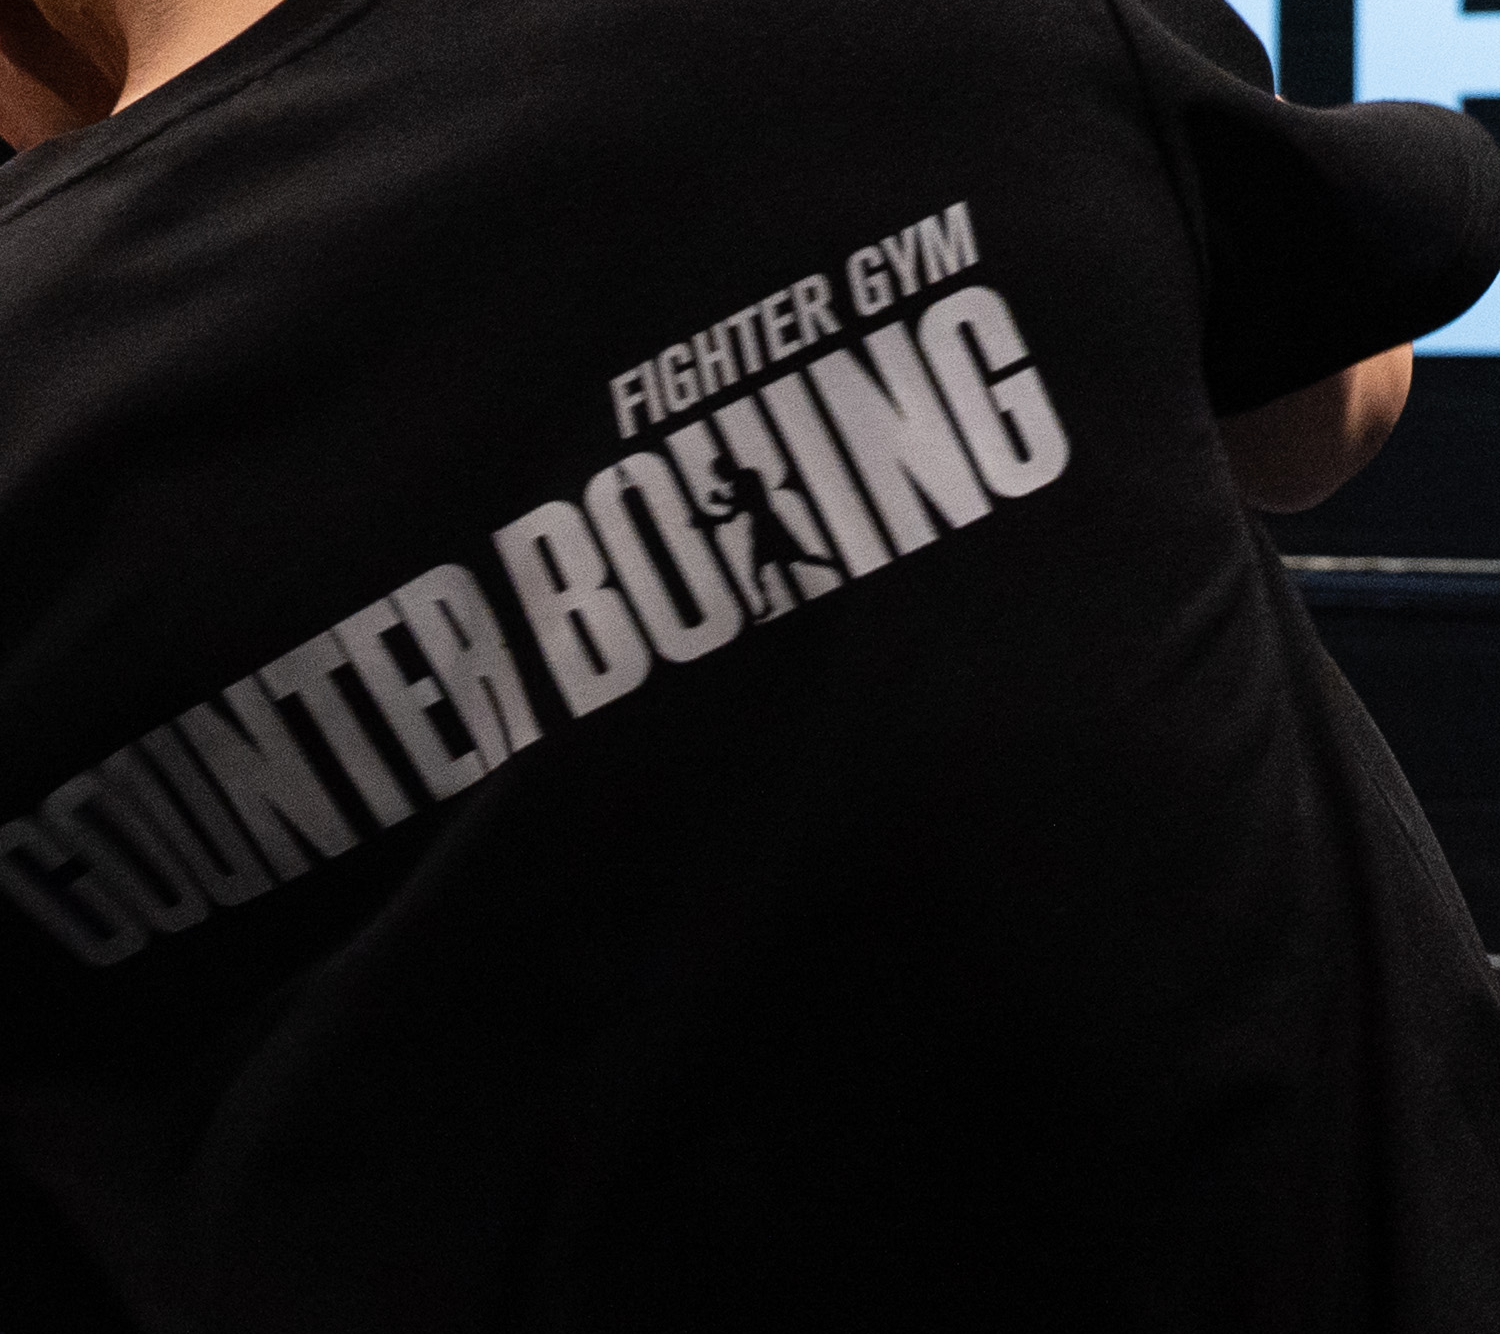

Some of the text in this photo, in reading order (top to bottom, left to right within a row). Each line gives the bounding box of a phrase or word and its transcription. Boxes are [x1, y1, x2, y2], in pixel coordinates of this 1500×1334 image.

[607, 199, 981, 440] FIGHTER GYM
[492, 284, 1070, 718] BOXING
